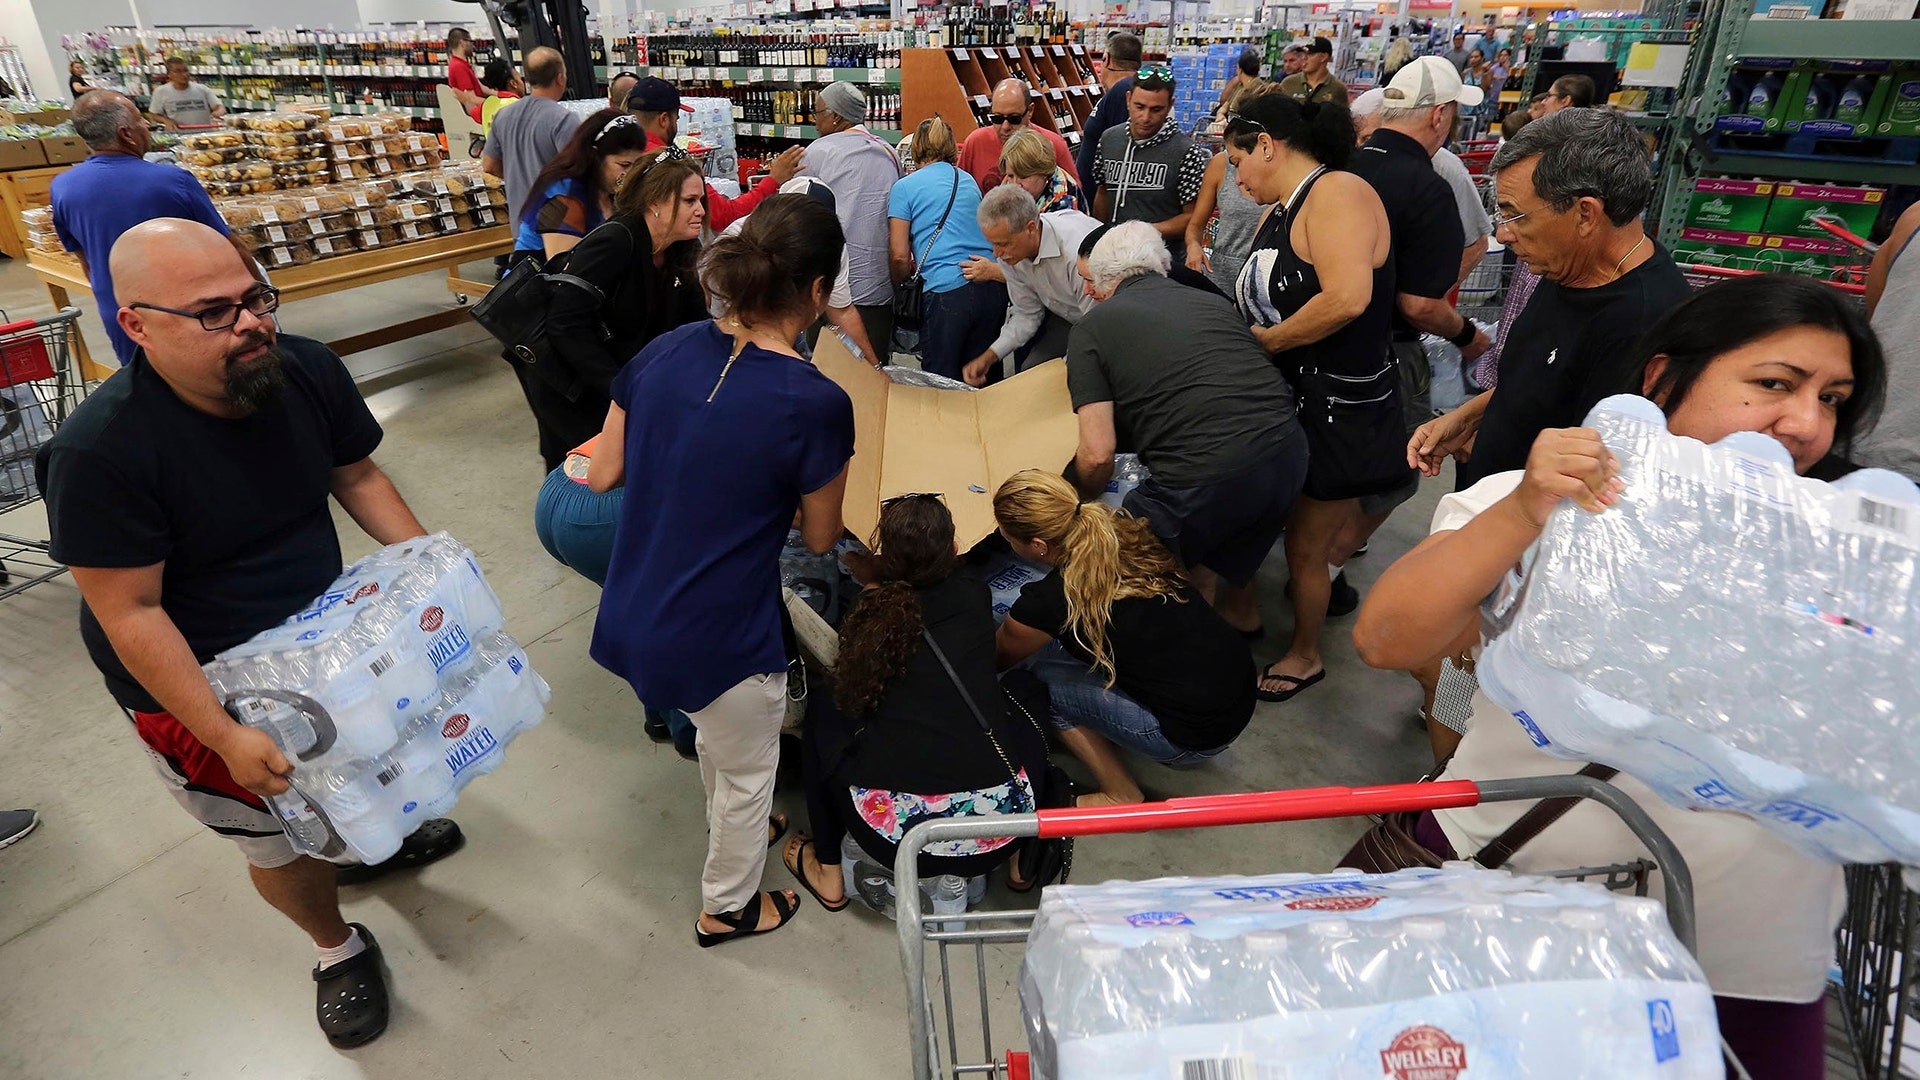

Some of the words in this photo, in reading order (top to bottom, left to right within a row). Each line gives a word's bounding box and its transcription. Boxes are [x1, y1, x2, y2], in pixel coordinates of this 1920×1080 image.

[990, 567, 1031, 590] WATER
[427, 623, 468, 668] WATER
[445, 726, 495, 772] WATER
[1382, 1045, 1462, 1071] WELLSLEY
